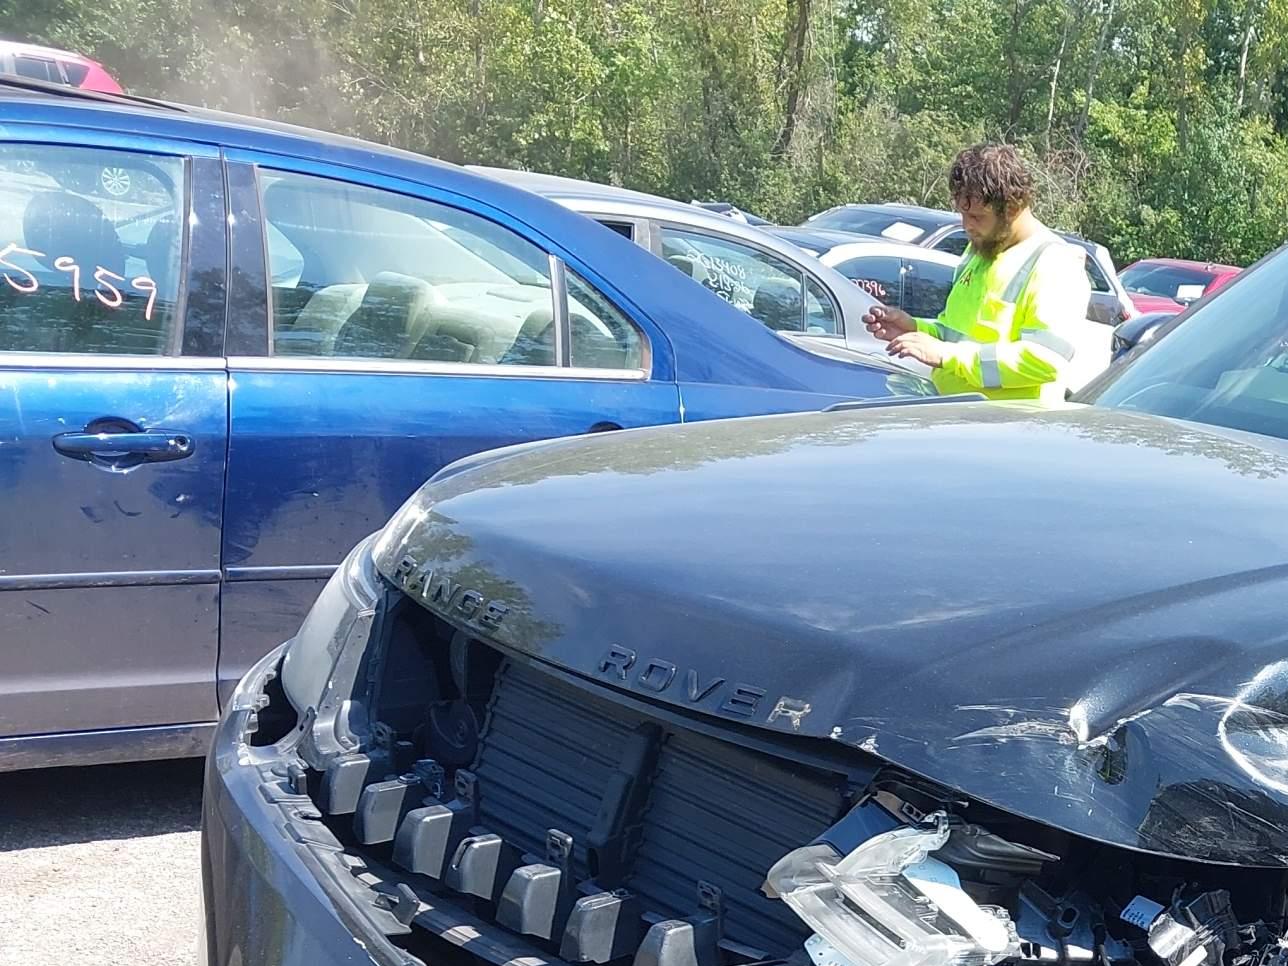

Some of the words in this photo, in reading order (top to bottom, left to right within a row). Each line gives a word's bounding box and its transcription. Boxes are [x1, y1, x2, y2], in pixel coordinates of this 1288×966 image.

[0, 243, 158, 321] 5959
[395, 554, 511, 630] RANGE
[599, 643, 812, 731] ROVER
